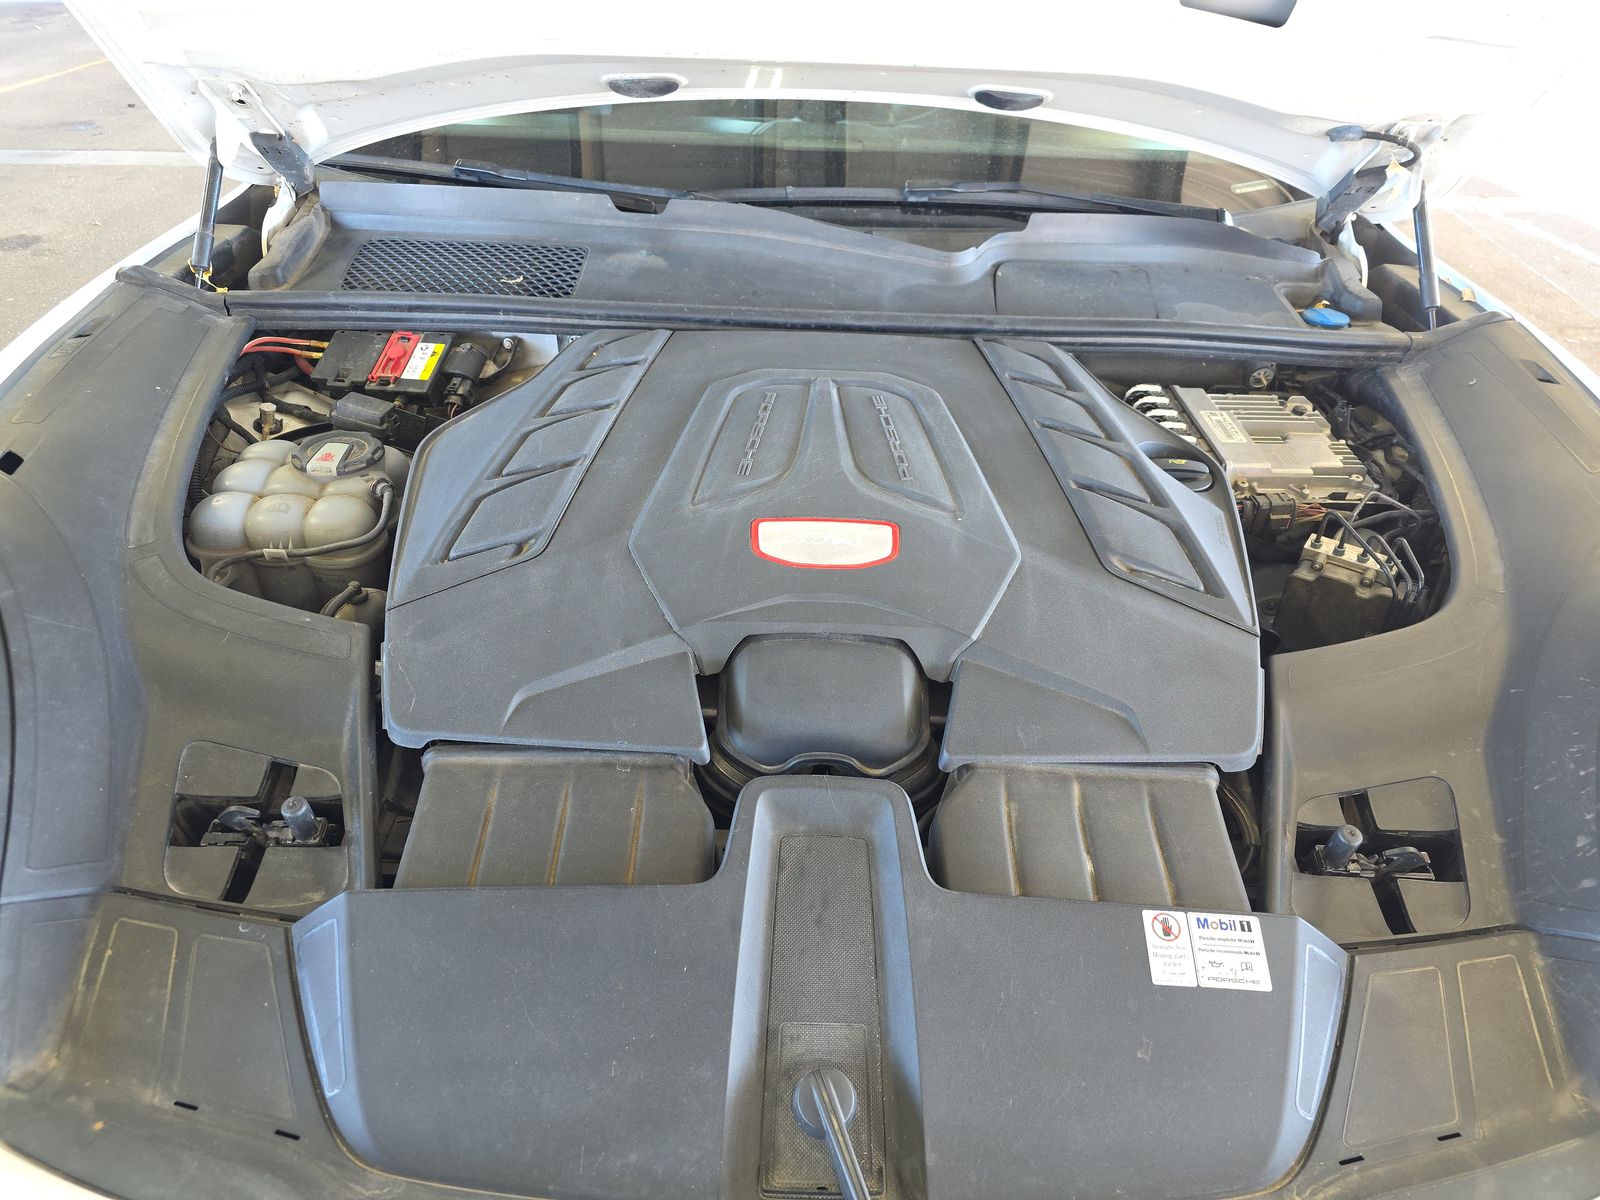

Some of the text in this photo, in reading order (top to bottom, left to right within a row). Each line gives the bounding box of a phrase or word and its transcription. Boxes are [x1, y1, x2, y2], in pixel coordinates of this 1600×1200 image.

[736, 391, 778, 476] PORSCHE
[871, 394, 914, 481] PORSCHE
[1196, 917, 1253, 932] Mobil 1
[1207, 976, 1261, 985] PORSCHE
